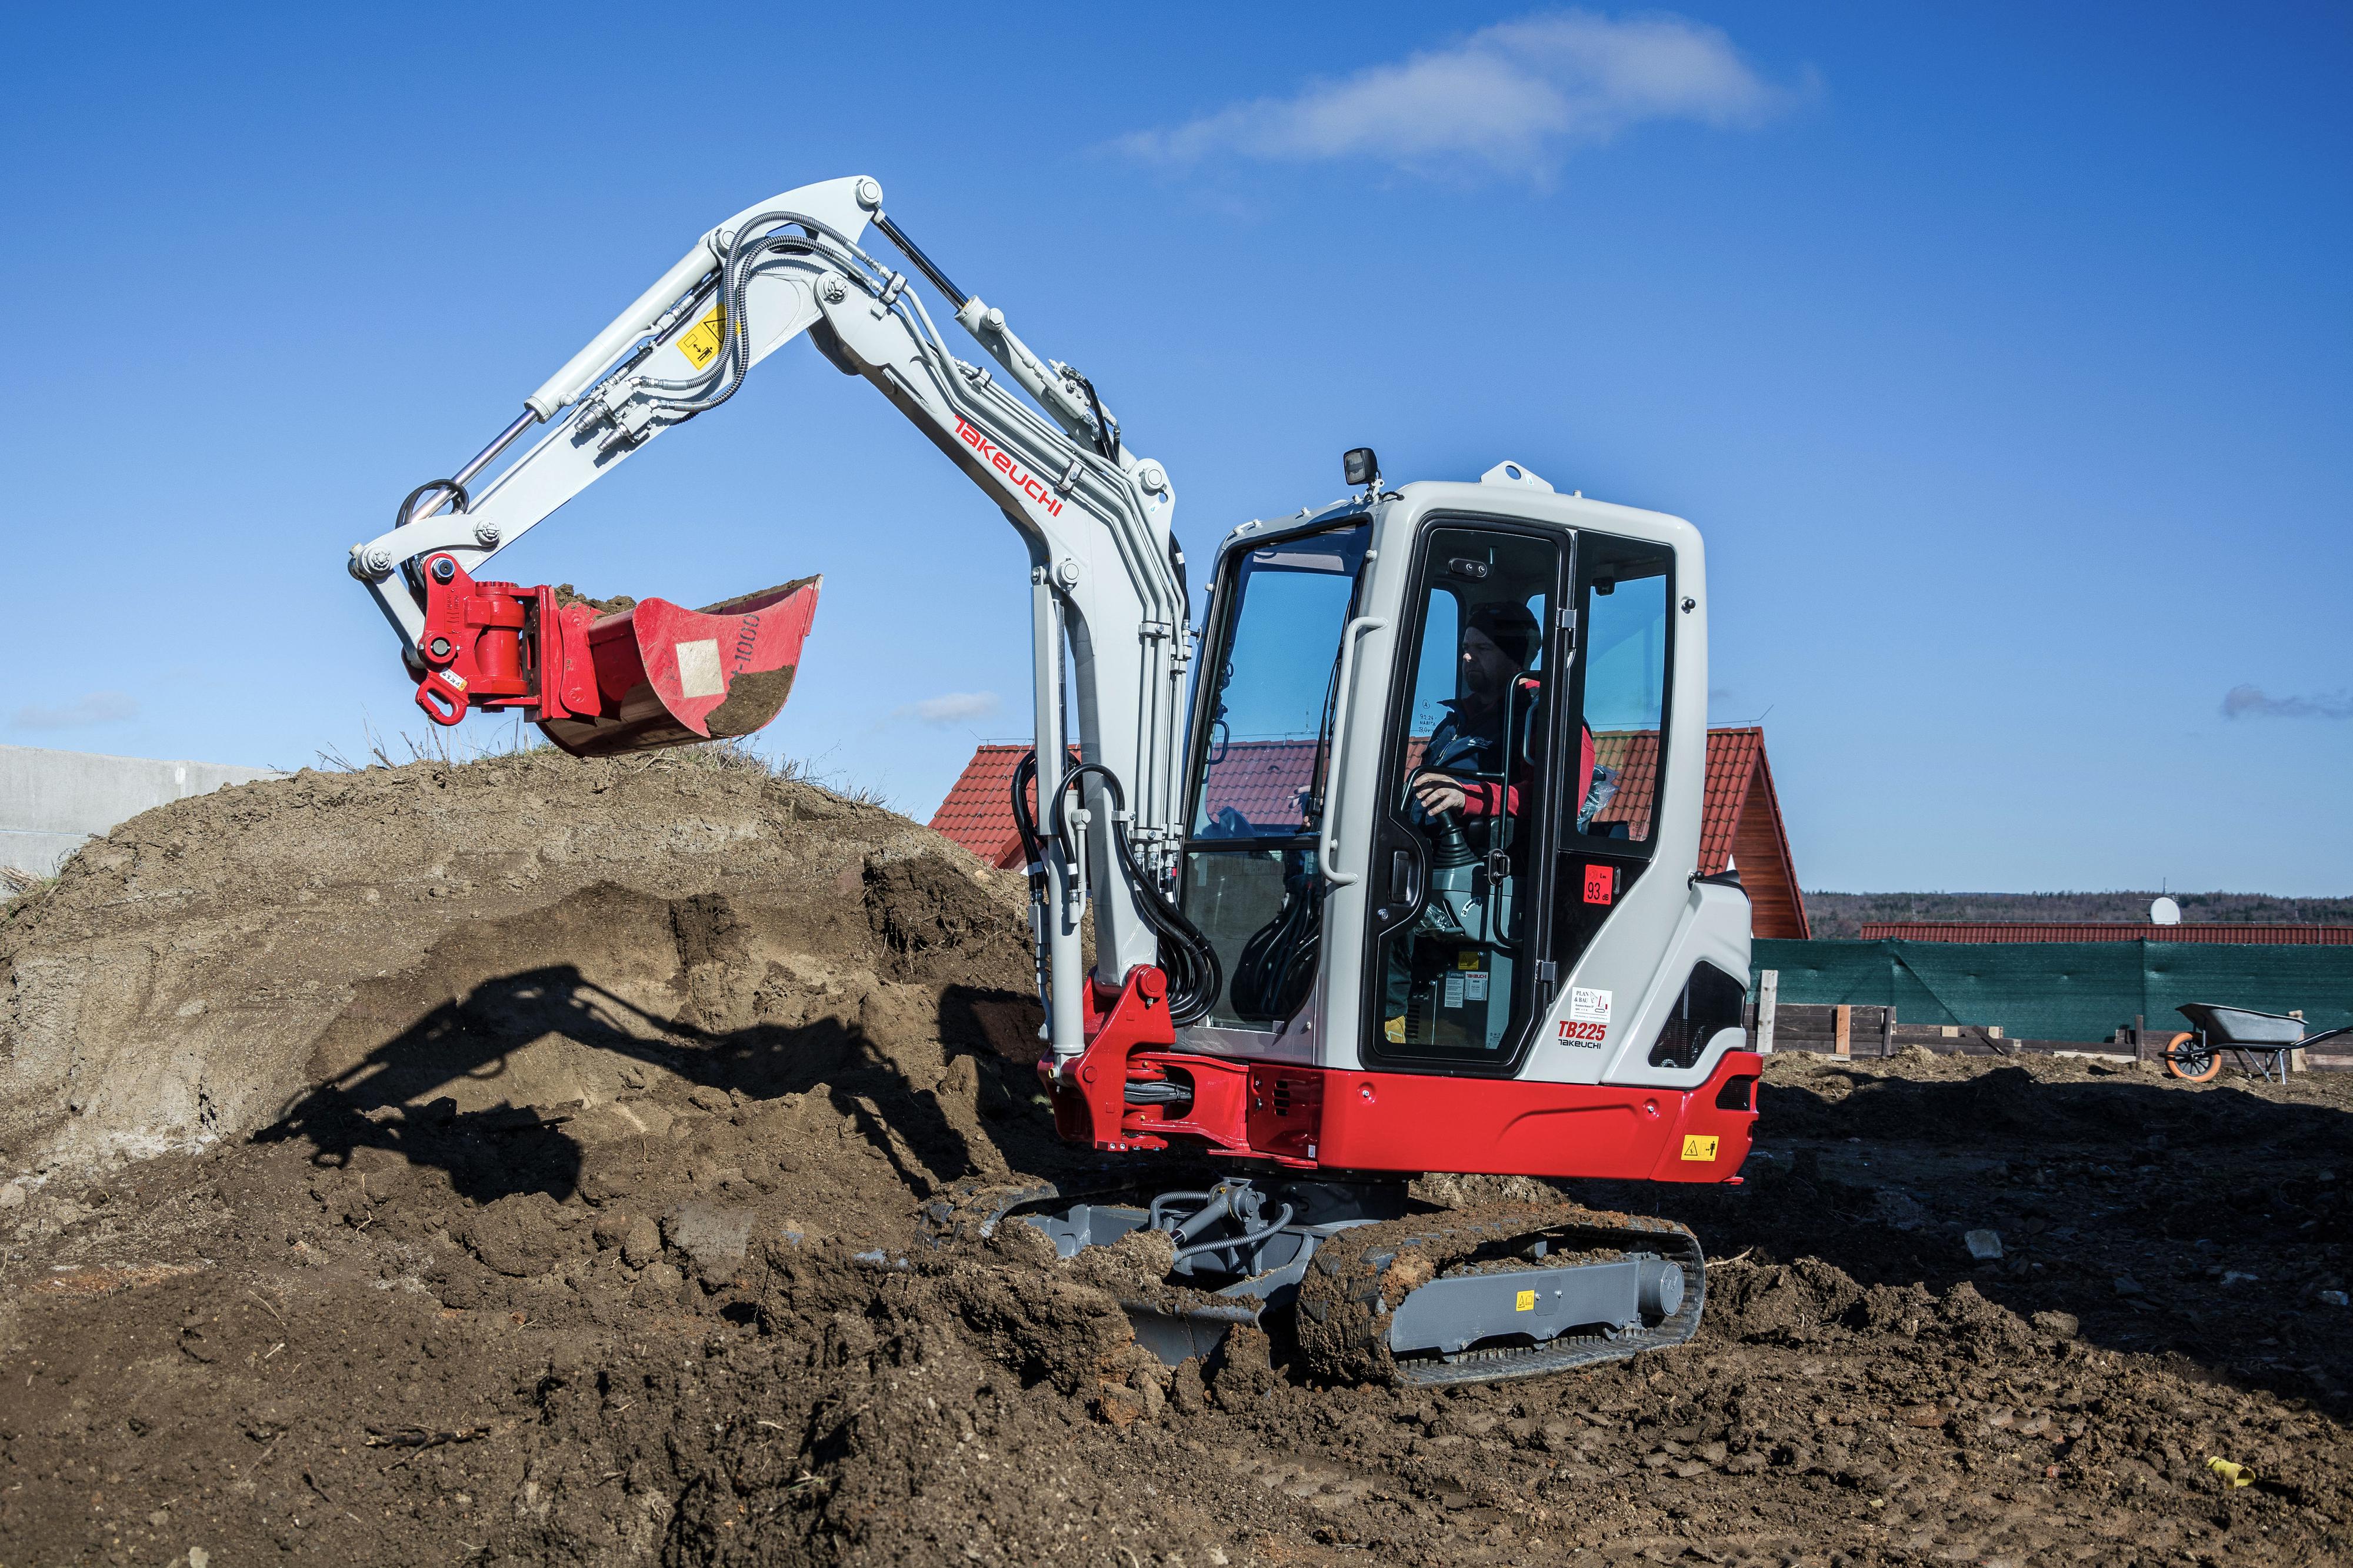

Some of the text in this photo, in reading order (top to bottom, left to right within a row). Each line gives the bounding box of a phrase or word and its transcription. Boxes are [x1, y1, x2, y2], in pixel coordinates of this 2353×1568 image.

[954, 413, 1064, 517] TAKEUCHI
[1587, 882, 1600, 900] 93
[1558, 1020, 1607, 1041] TB225
[1558, 1039, 1601, 1049] TAKEUCHI
